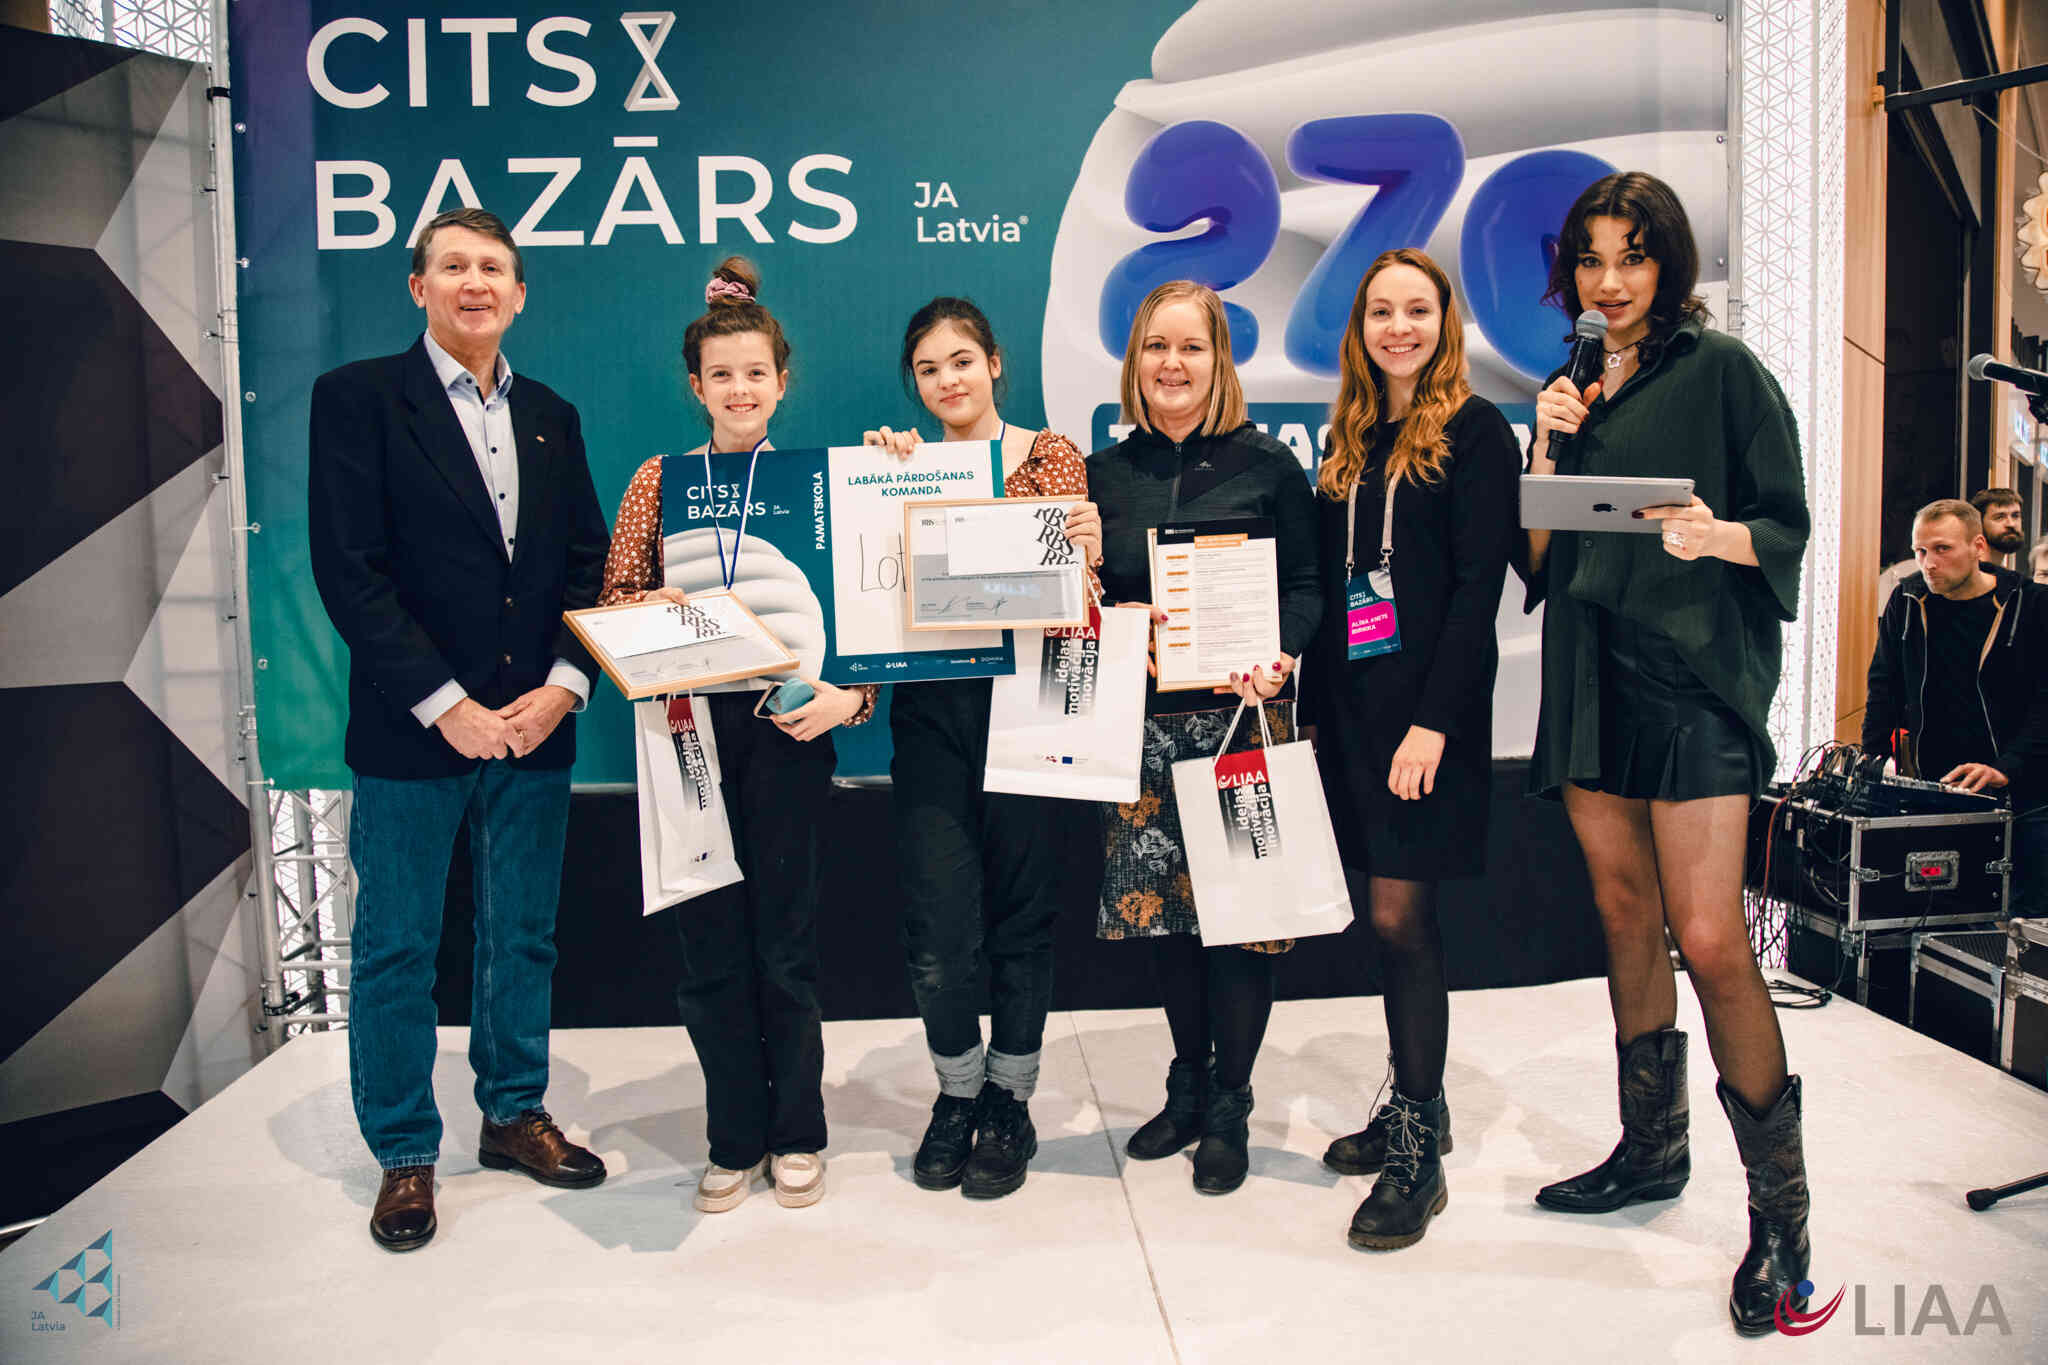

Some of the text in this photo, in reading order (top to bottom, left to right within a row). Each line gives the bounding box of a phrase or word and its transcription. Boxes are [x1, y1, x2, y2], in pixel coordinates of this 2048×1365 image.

[306, 17, 597, 109] CITS
[316, 136, 858, 250] BAZĀRS
[913, 181, 959, 208] JA
[848, 470, 975, 486] LABĀKĀ PĀRDOŠANAS
[881, 485, 942, 497] KOMANDA
[688, 501, 766, 519] BAZĀRS
[813, 471, 825, 550] PAMATSKOLA
[1040, 549, 1079, 566] RB
[1063, 627, 1096, 638] LIAA
[1056, 638, 1072, 684] idejas
[1067, 641, 1084, 716] motivācij
[1082, 640, 1098, 705] novācija
[1232, 771, 1266, 786] LIAA
[1233, 787, 1250, 831] idejas
